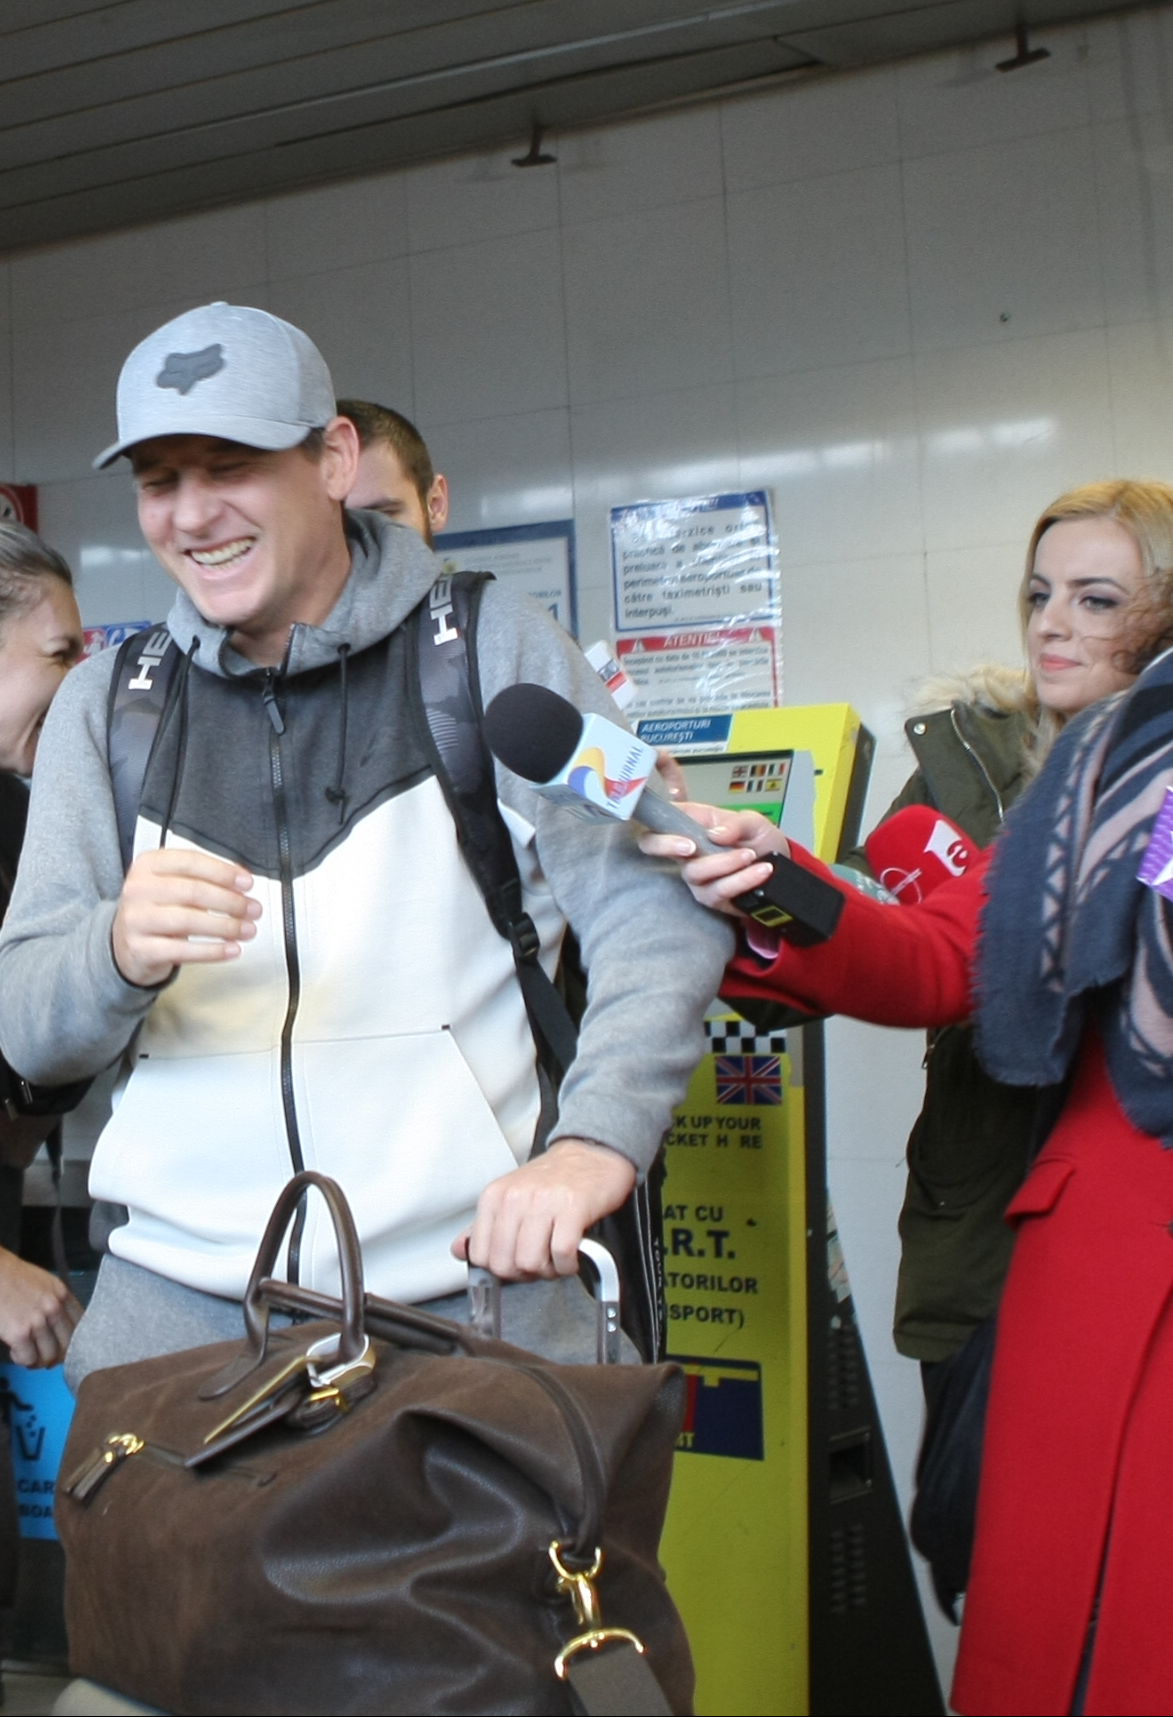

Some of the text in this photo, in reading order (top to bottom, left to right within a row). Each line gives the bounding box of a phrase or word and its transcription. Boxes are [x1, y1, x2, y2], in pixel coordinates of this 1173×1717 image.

[739, 582, 763, 593] sau
[641, 718, 711, 733] AEROPORTURI
[691, 1116, 712, 1129] UP
[715, 1116, 762, 1131] YOUR
[665, 1133, 709, 1147] CKET
[694, 1205, 724, 1223] CU
[665, 1271, 759, 1295] TORILOR
[666, 1303, 745, 1330] SPORT)
